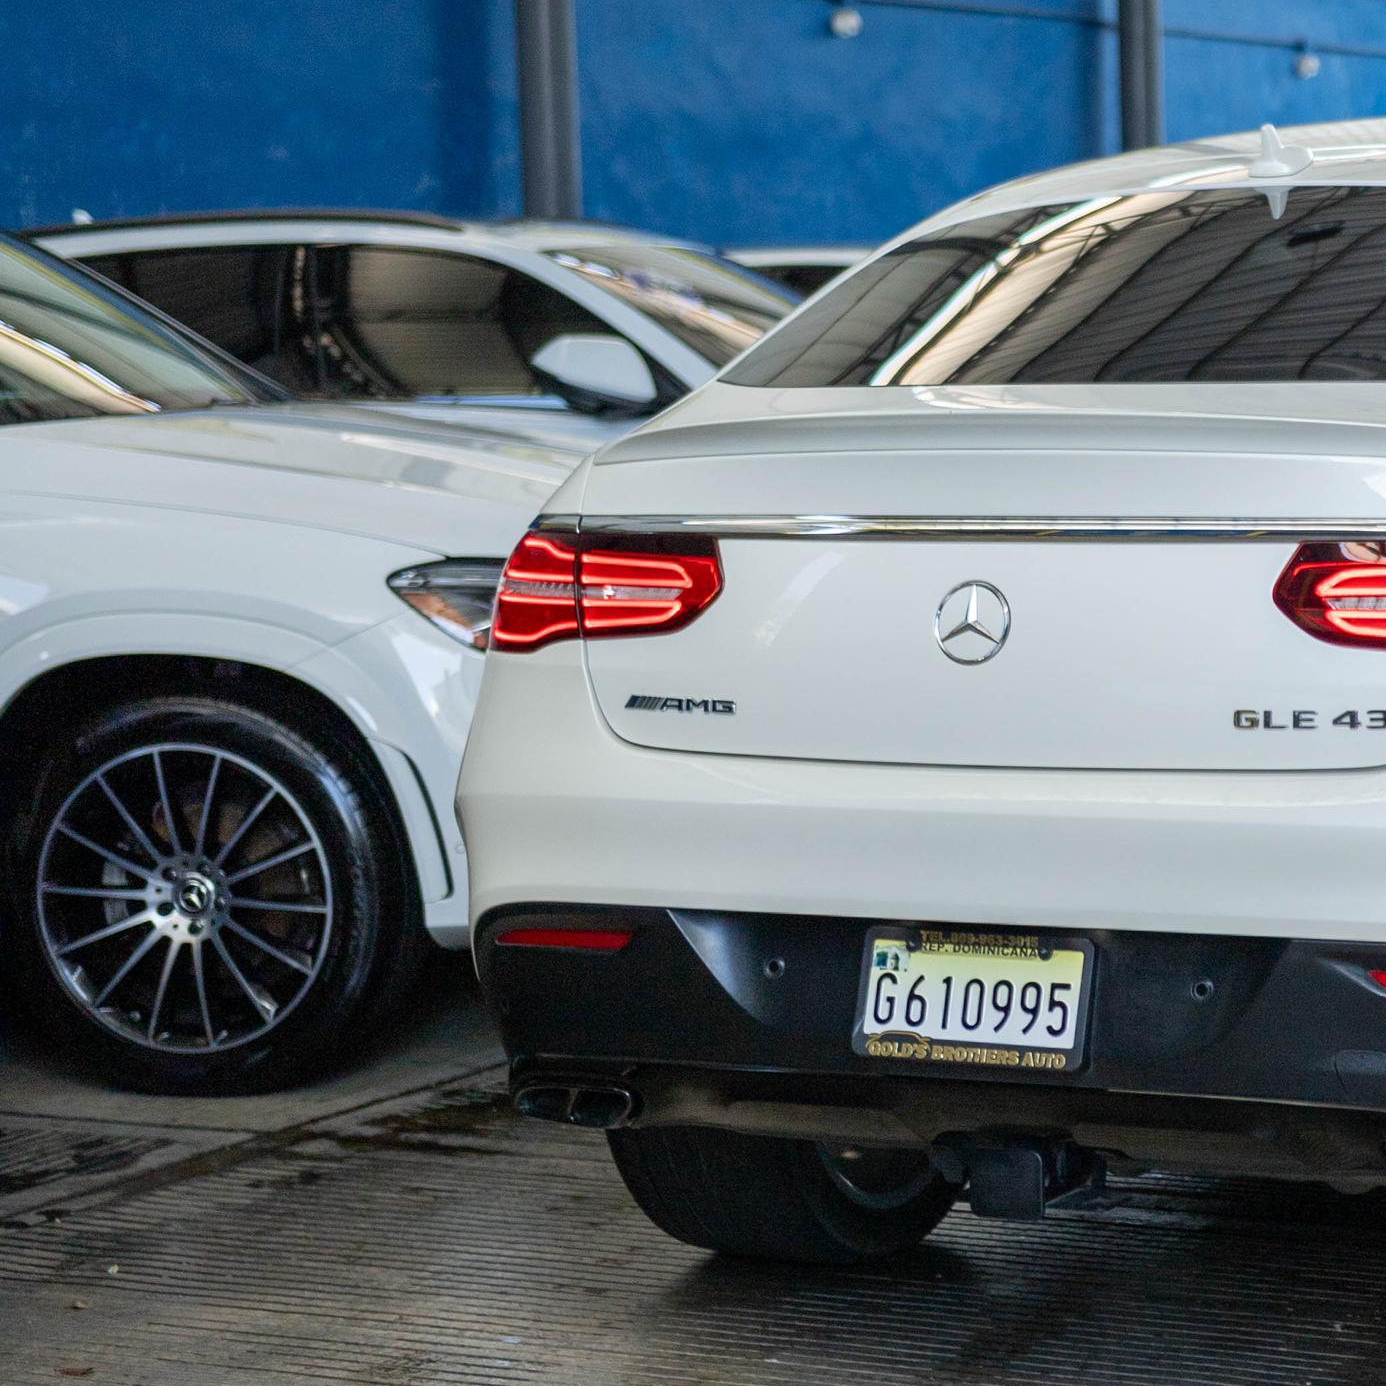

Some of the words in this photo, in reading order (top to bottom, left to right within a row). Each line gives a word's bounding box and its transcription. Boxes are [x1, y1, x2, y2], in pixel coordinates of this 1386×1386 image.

[659, 697, 737, 715] AMG
[1233, 709, 1319, 730] GLE
[953, 944, 1038, 958] DOMINICANA
[873, 972, 1072, 1037] G610995
[868, 1041, 928, 1060] GOLD'S
[931, 1045, 1019, 1066] BROTHERS
[1021, 1051, 1067, 1070] AUTO
